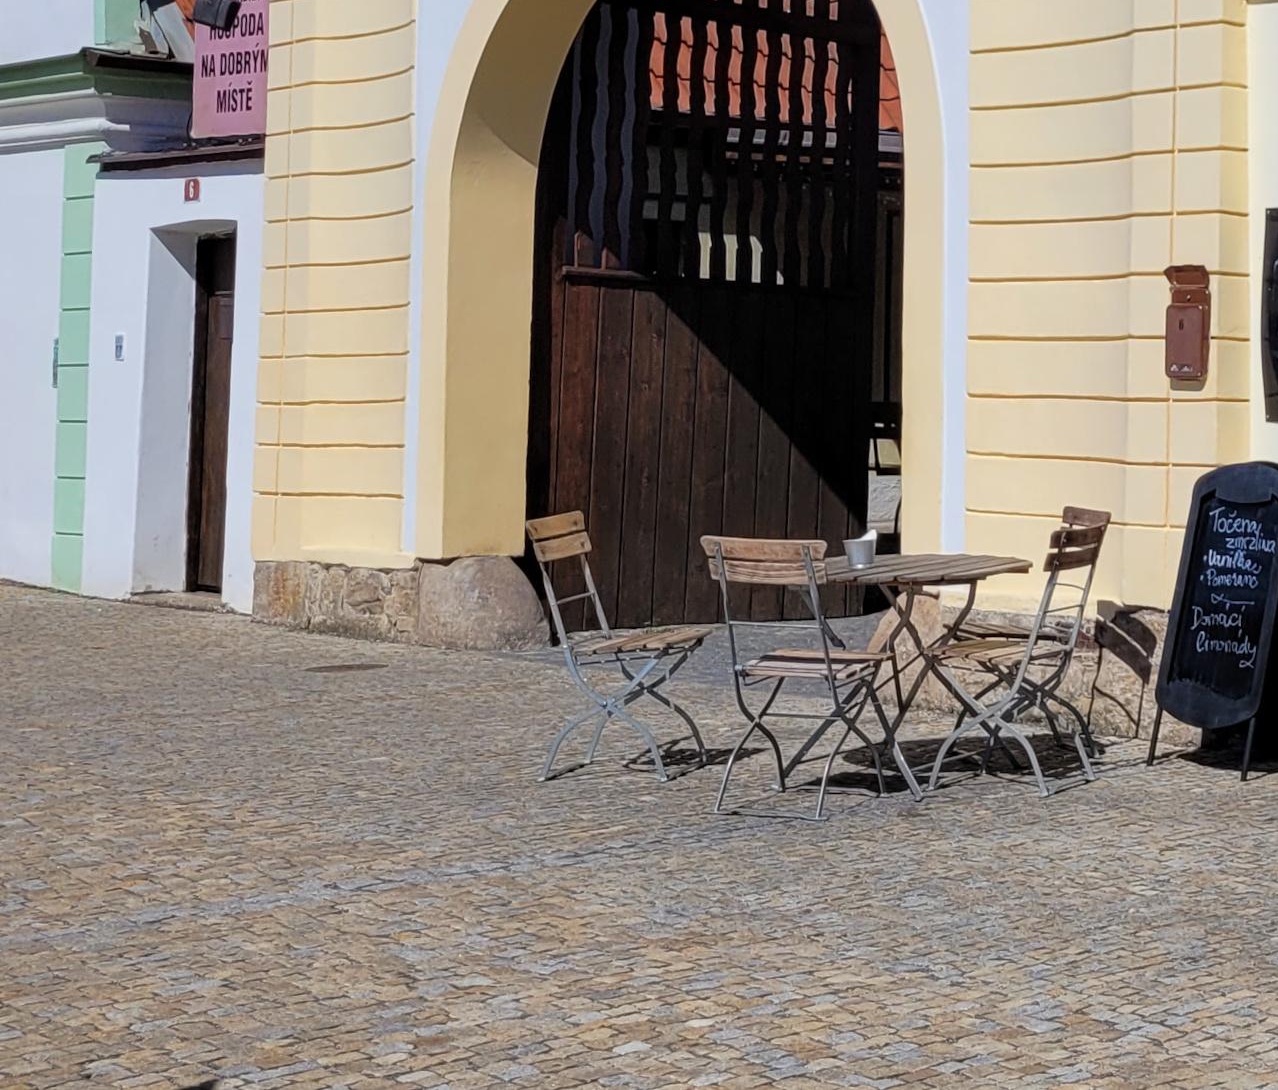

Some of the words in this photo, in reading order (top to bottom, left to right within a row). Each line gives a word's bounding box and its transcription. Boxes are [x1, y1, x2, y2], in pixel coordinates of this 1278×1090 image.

[201, 54, 216, 79] NA
[216, 80, 253, 113] MÍSTĚ
[189, 181, 195, 198] 6
